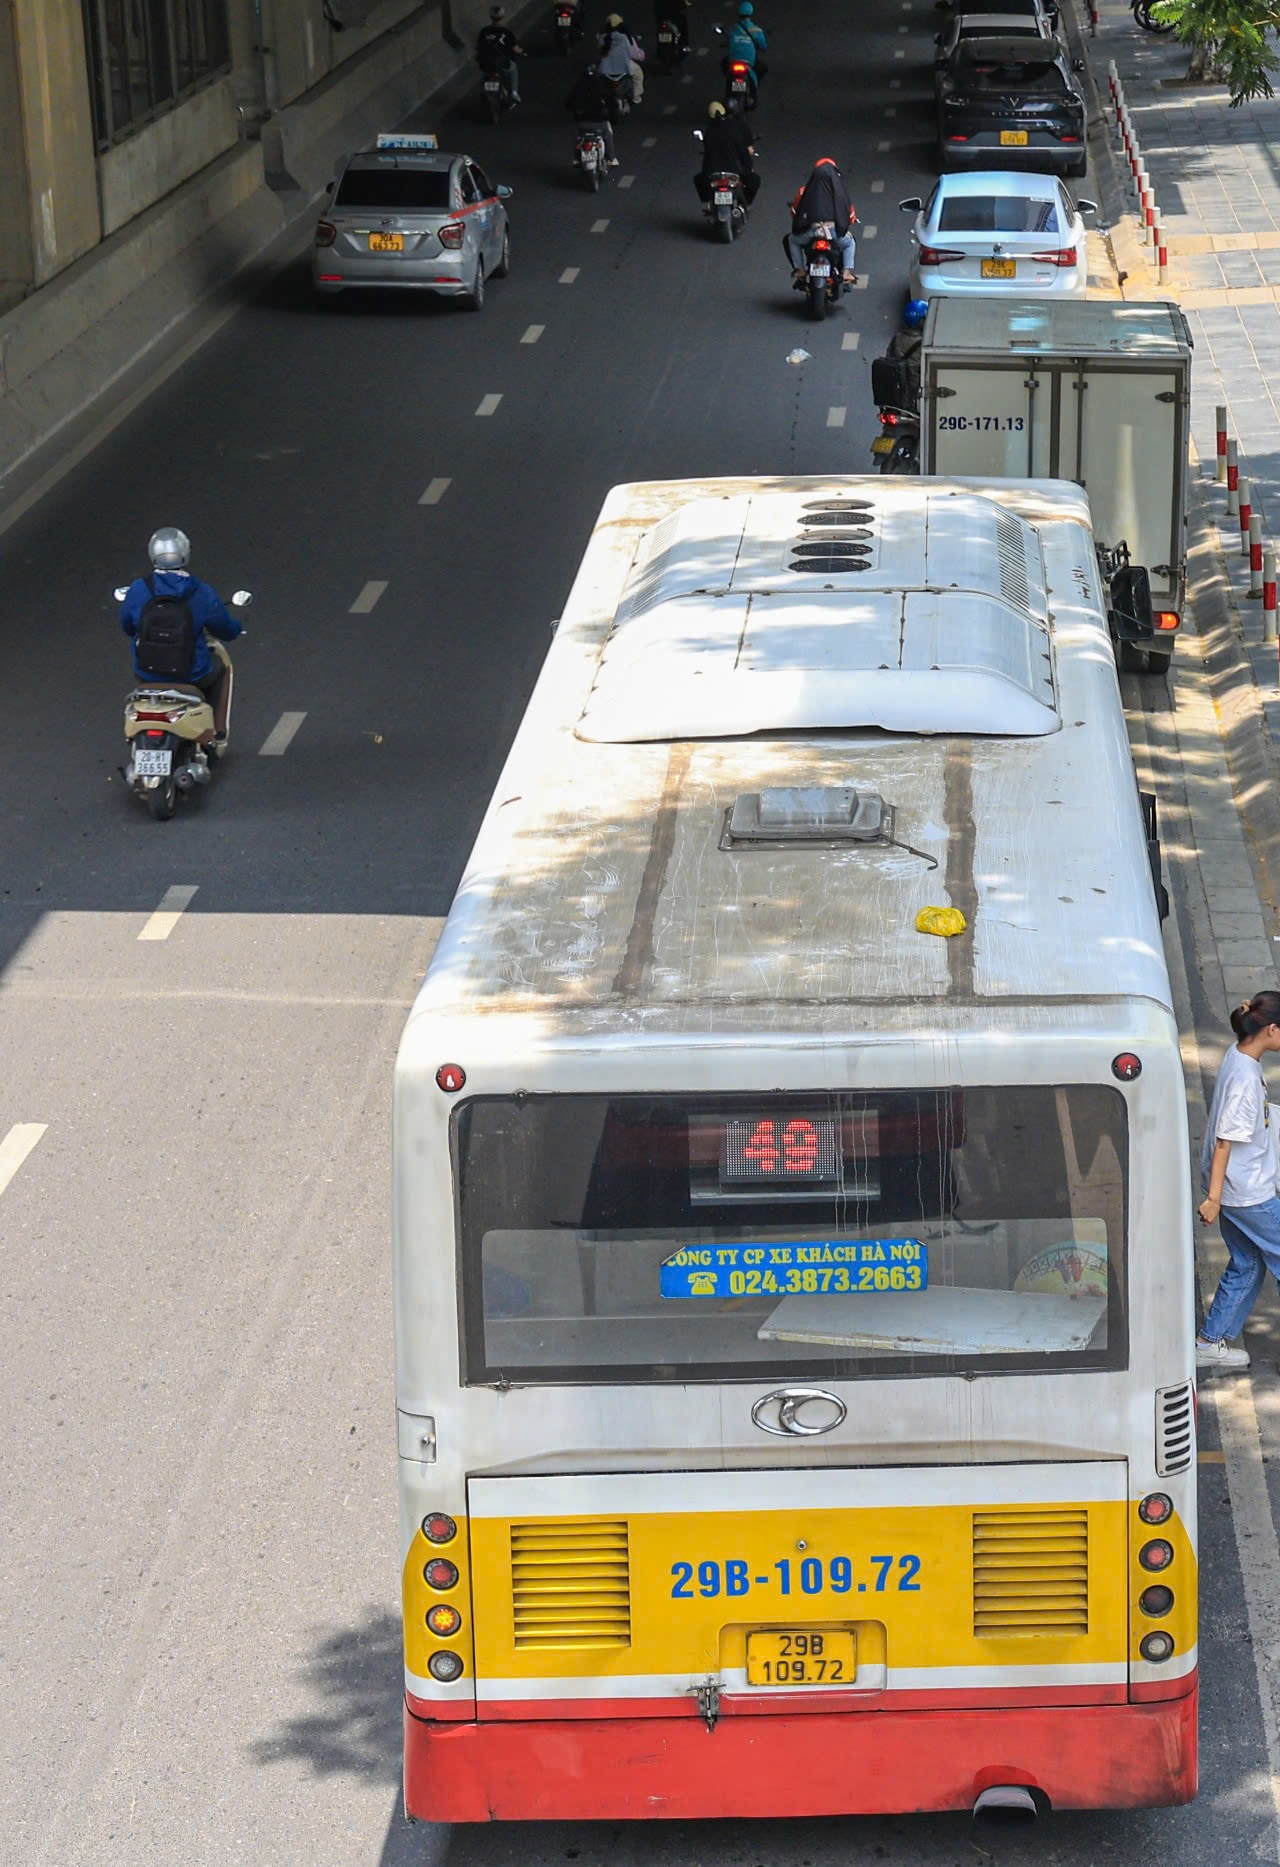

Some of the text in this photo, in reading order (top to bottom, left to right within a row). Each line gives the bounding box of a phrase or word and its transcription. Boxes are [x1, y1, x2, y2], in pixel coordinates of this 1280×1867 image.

[938, 416, 1024, 431] 29C-171.13
[743, 1120, 819, 1171] 49
[667, 1241, 921, 1267] ONG TY CP XE KHÁCH HÀ NỘI
[729, 1265, 922, 1294] 024.3873.2663
[671, 1554, 921, 1599] 29B-109.72
[779, 1635, 824, 1657] 29B
[763, 1659, 843, 1682] 109.72
